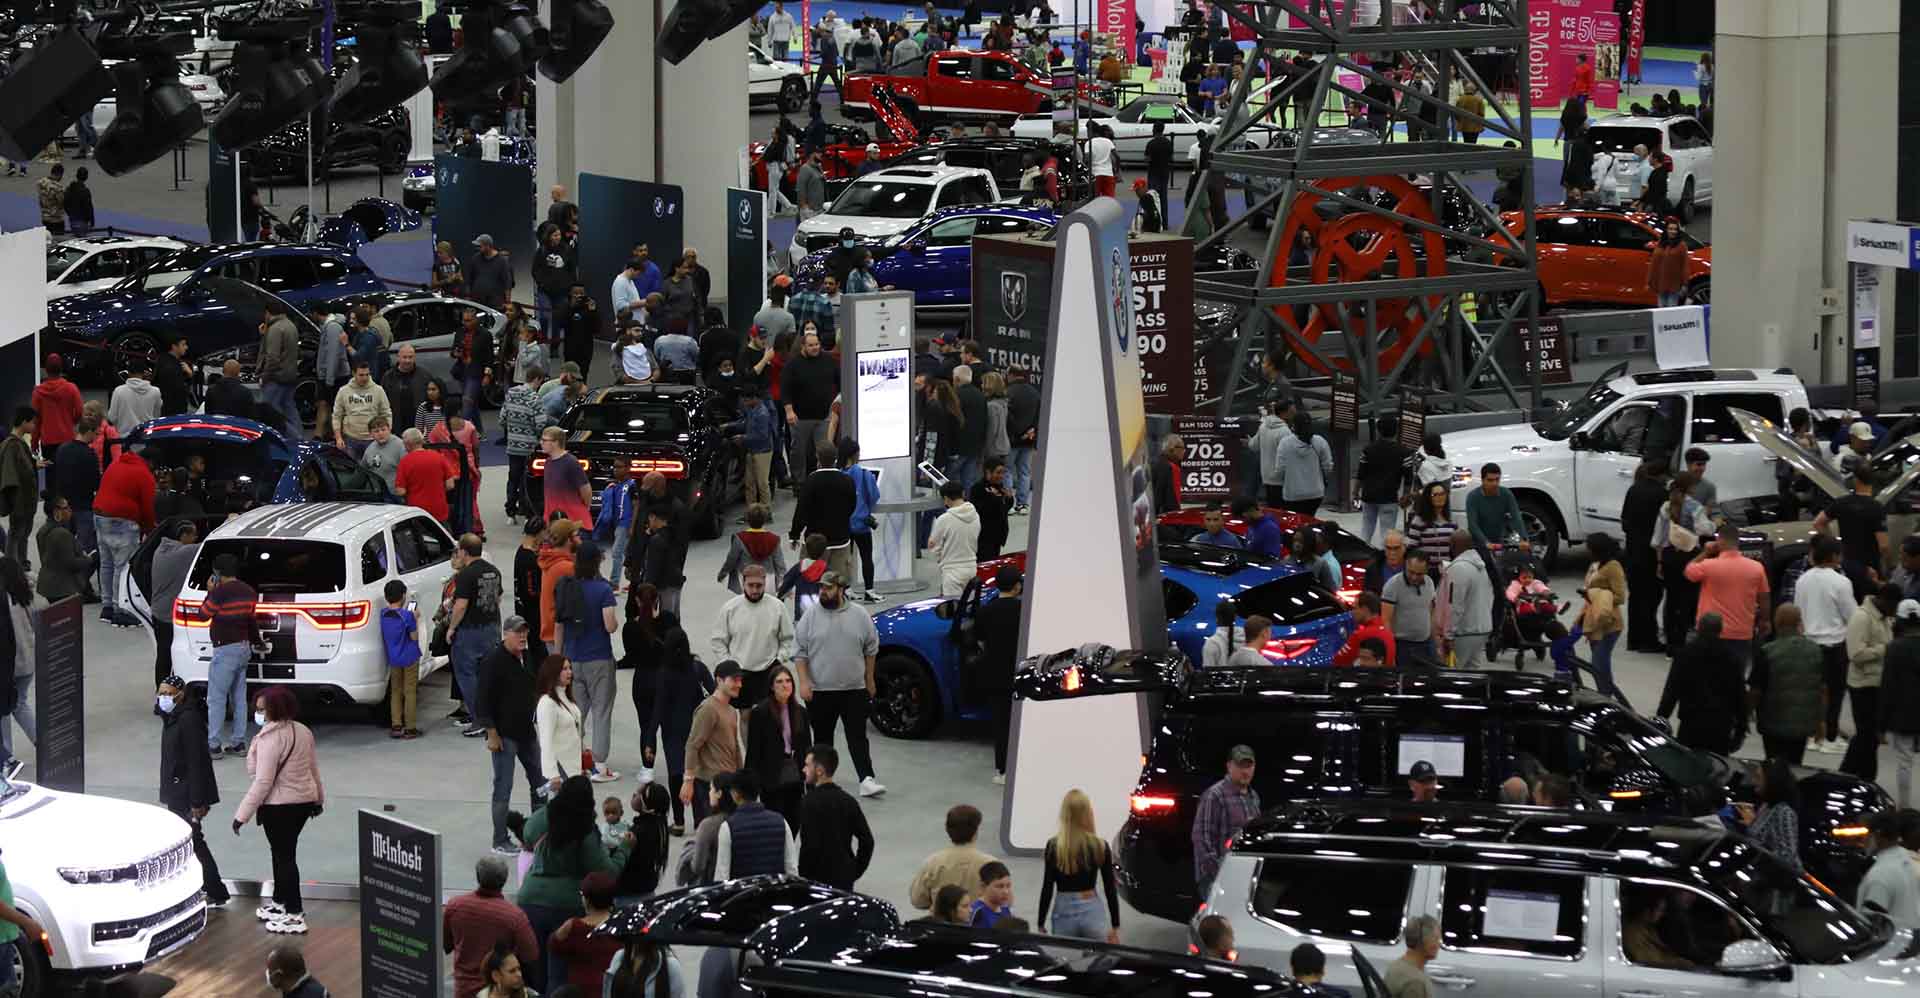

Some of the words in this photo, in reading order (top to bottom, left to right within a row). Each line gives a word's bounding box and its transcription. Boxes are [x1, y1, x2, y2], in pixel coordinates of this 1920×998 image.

[1107, 0, 1126, 48] Mobil
[1142, 254, 1166, 263] DUTY
[997, 325, 1031, 339] RAM
[1186, 443, 1225, 460] 702
[1186, 472, 1226, 487] 650
[371, 829, 422, 873] McIntosh
